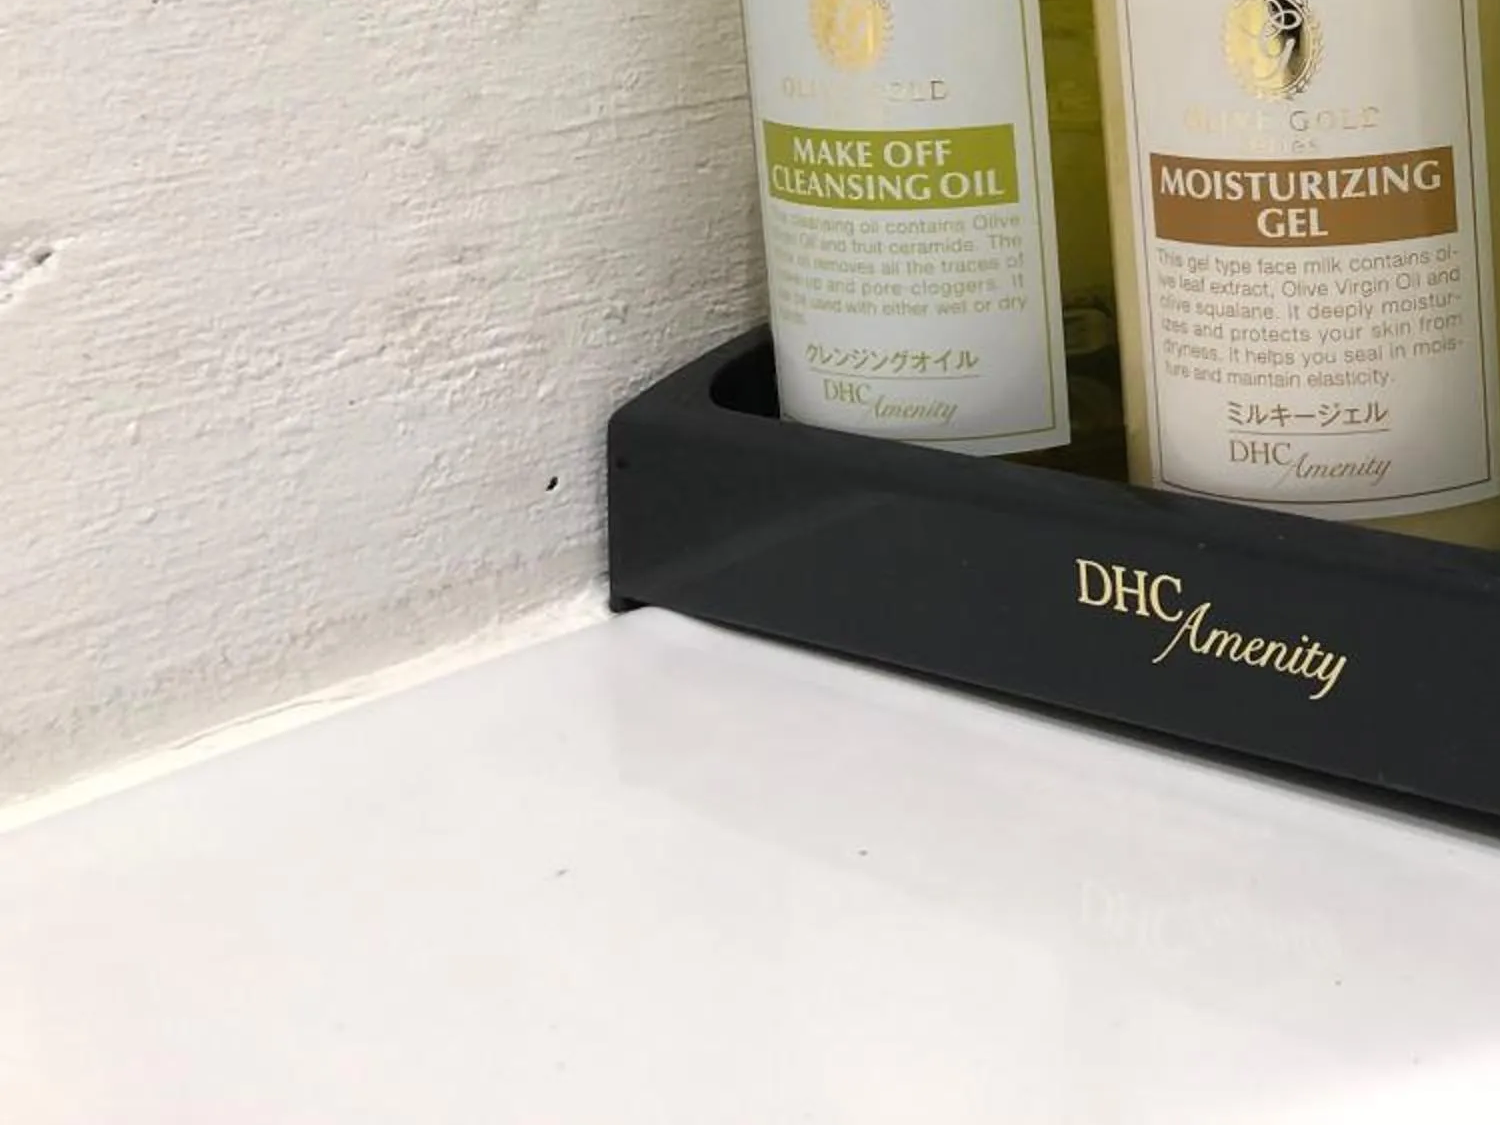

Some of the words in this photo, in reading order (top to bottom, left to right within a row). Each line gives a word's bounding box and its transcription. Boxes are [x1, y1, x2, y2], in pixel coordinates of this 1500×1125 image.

[792, 136, 874, 168] MAKE
[882, 138, 953, 169] OFF
[771, 164, 931, 201] CLEANSING
[939, 169, 1006, 200] OIL
[1160, 159, 1442, 203] MOISTURIZING
[973, 213, 1022, 231] Olive
[1257, 208, 1329, 238] GEL
[906, 259, 935, 276] the
[1156, 246, 1183, 268] This
[1186, 253, 1210, 274] gel
[1214, 256, 1252, 277] type
[1257, 257, 1298, 275] face
[1303, 256, 1342, 275] milk
[1349, 250, 1431, 273] contains
[1179, 274, 1206, 293] leaf
[1281, 278, 1329, 298] Olive
[1334, 277, 1390, 298] Virgin
[1395, 271, 1422, 291] Oil
[1426, 265, 1462, 287] and
[973, 299, 992, 314] or
[1287, 302, 1300, 319] It
[1307, 299, 1374, 322] deeply
[1193, 322, 1224, 341] and
[1230, 326, 1311, 343] protects
[1318, 326, 1363, 345] your
[1371, 321, 1412, 339] skin
[1419, 313, 1463, 333] from
[806, 342, 980, 374] クレンジングオイル
[1245, 346, 1296, 365] helps
[1301, 349, 1337, 368] you
[1343, 344, 1383, 364] seal
[1388, 342, 1407, 360] in
[822, 378, 873, 404] DHC
[1193, 365, 1222, 384] and
[1226, 369, 1301, 388] maintain
[1226, 399, 1389, 427] ミルキージェル
[1229, 438, 1292, 466] DHC
[1280, 452, 1394, 487] Amenity
[1075, 558, 1184, 623] DHC
[1151, 601, 1347, 700] Amenity
